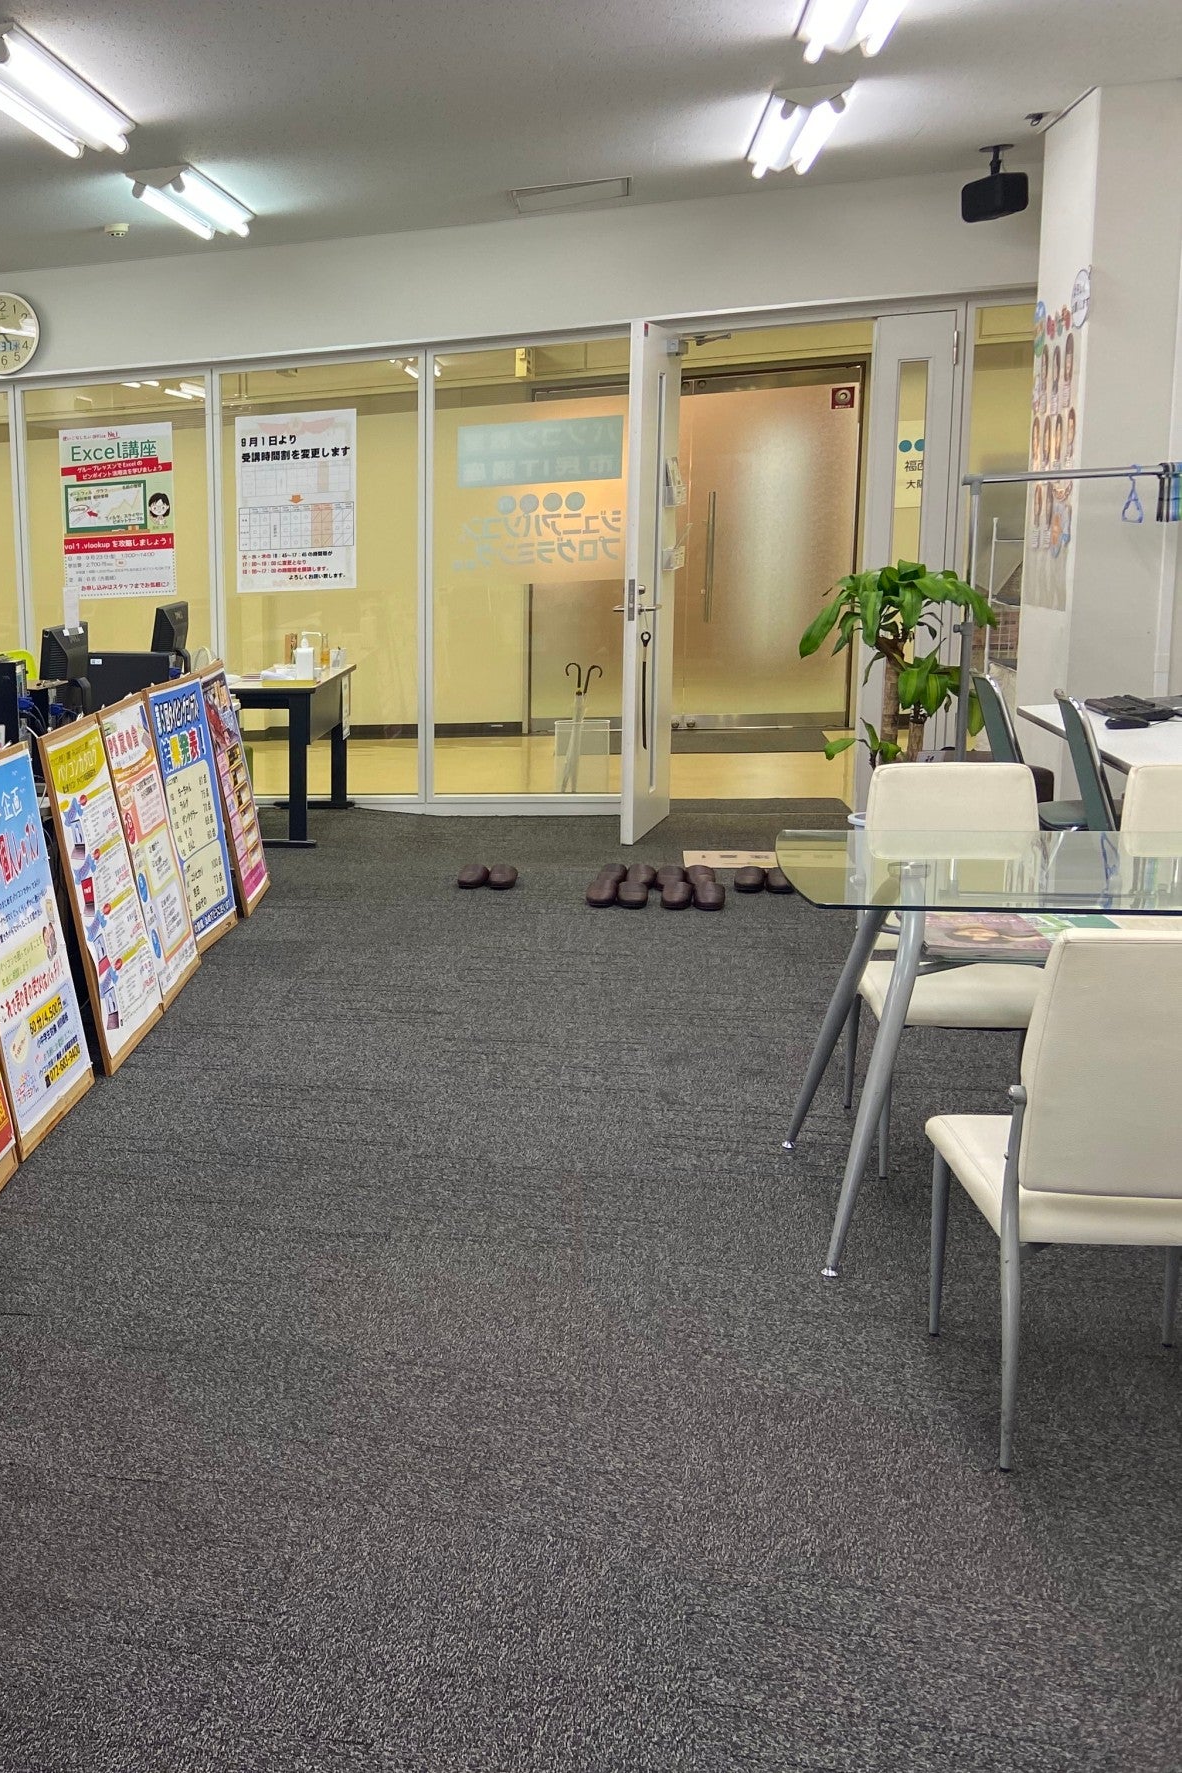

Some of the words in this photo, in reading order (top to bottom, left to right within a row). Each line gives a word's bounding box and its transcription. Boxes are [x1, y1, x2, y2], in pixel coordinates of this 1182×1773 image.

[22, 341, 29, 350] 4
[1, 355, 8, 366] 6
[14, 352, 20, 362] 5
[71, 439, 157, 461] Excel講座
[241, 446, 350, 463] 受講時間割を変更します
